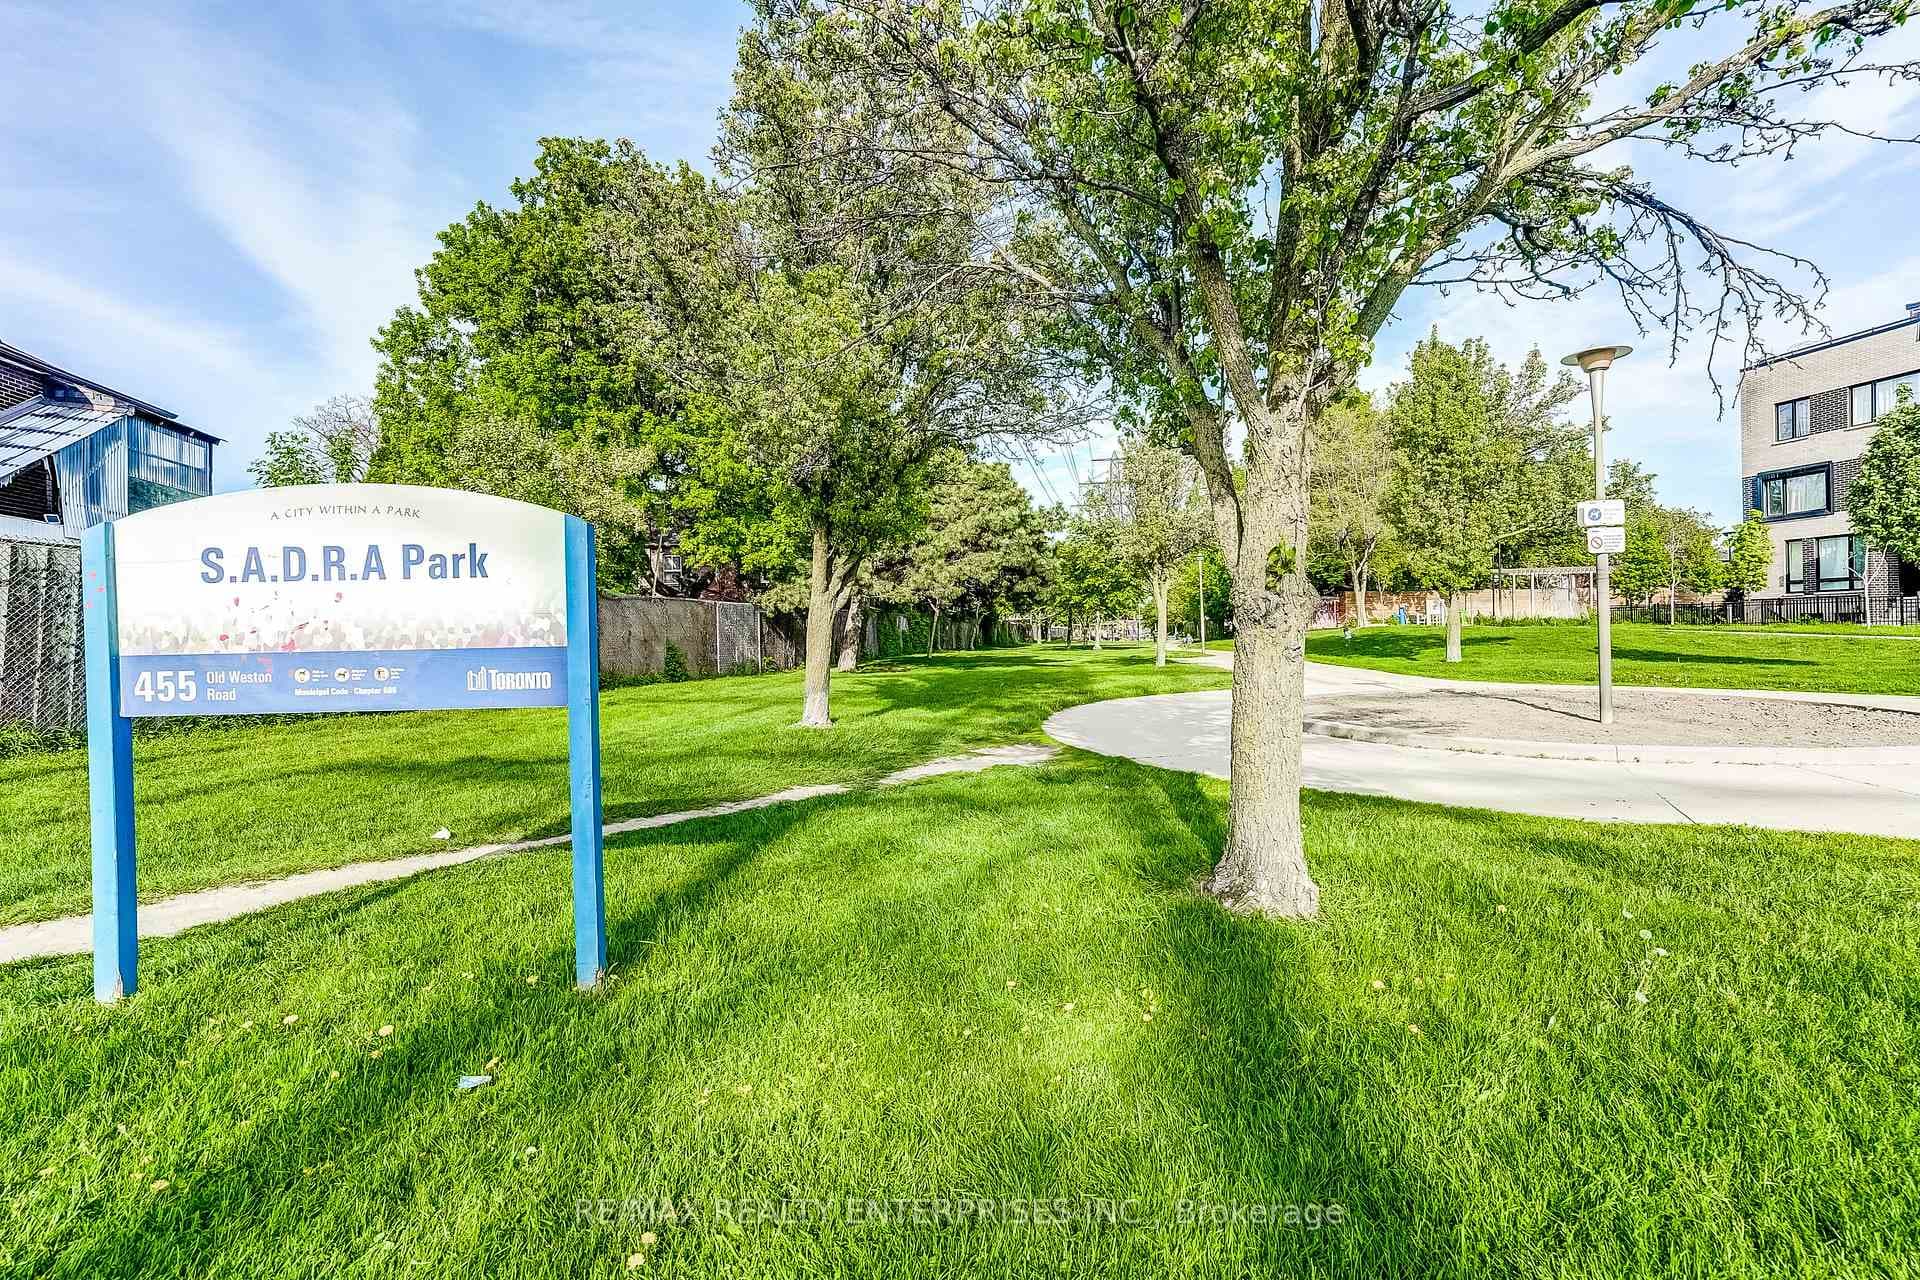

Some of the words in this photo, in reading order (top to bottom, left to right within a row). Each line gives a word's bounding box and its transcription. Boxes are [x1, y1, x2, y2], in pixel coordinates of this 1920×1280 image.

[270, 511, 280, 520] A
[285, 507, 313, 518] CITY
[319, 505, 367, 515] WITHIN
[372, 505, 381, 514] A
[386, 505, 421, 518] PARK
[200, 544, 387, 584] S.A.D.R.A
[402, 542, 489, 580] Park
[206, 671, 225, 684] Old
[229, 670, 272, 684] Weston
[487, 669, 552, 690] TORONTO
[134, 670, 197, 702] 455
[331, 687, 348, 695] Code
[207, 688, 236, 701] Road
